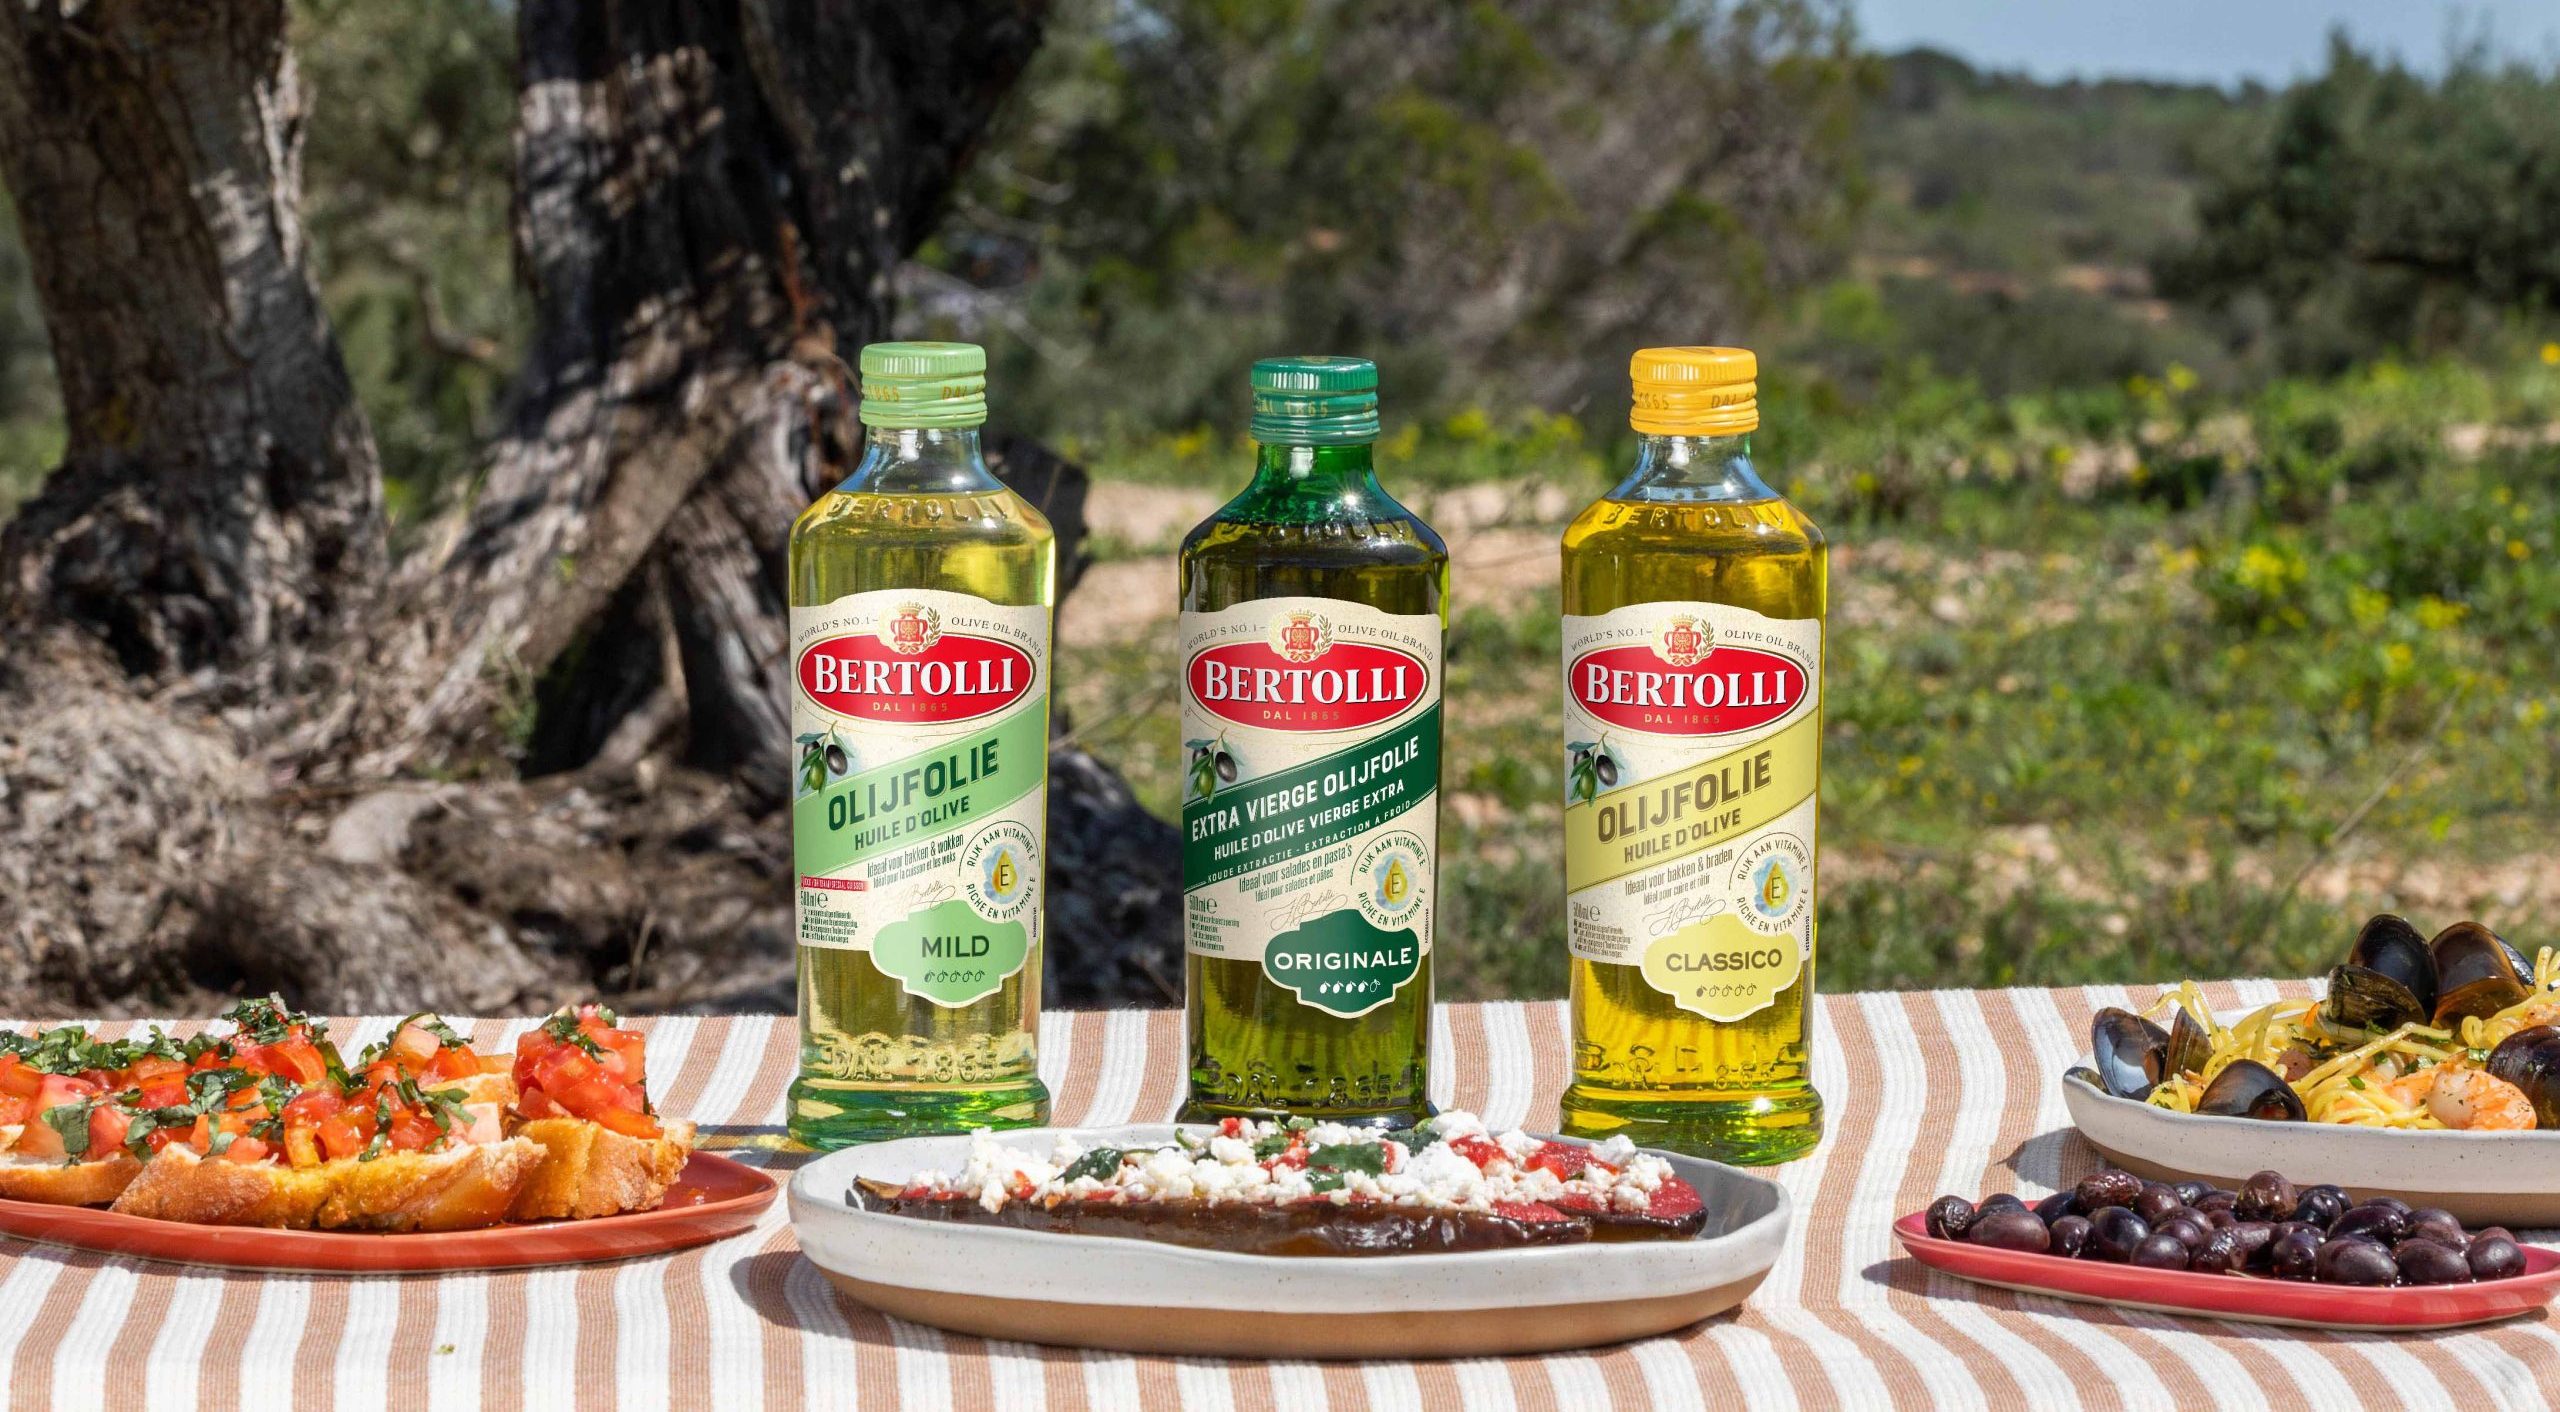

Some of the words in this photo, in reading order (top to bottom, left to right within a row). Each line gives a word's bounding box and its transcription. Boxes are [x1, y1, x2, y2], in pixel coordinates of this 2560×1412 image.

[798, 619, 840, 643] WORLD'S
[951, 616, 989, 630] OLIVE
[993, 621, 1012, 636] OIL
[1014, 629, 1043, 658] BRAND
[1186, 626, 1227, 651] WORLD'S
[1338, 624, 1376, 636] OLIVE
[1381, 629, 1399, 641] OIL
[1403, 635, 1434, 661] BRAND
[1571, 630, 1613, 652] WORLD'S
[1725, 628, 1762, 642] OLIVE
[1766, 634, 1784, 647] OIL
[1786, 641, 1815, 670] BRAND
[814, 653, 1014, 696] BERTOLLI
[1204, 659, 1407, 704] BERTOLLI
[1586, 662, 1788, 708] BERTOLLI
[873, 702, 901, 712] DAL
[911, 702, 948, 712] 1865
[1263, 710, 1292, 720] DAL
[1302, 711, 1340, 721] 1865
[1644, 713, 1673, 723] DAL
[1684, 714, 1720, 724] 1865
[828, 738, 1000, 831] OLIJFOLIE
[1192, 808, 1240, 842] EXTRA
[1245, 779, 1318, 822] VIERGE
[1323, 735, 1420, 797] OLIJFOLIE
[1598, 750, 1772, 844] OLIJFOLIE
[855, 820, 900, 851] HUILE
[906, 795, 970, 833] D'OLIVE
[1214, 836, 1249, 861] HUILE
[1252, 818, 1305, 848] D'OLIVE
[1309, 798, 1360, 829] VIERGE
[1363, 778, 1405, 809] EXTRA
[1624, 838, 1671, 863] HUILE
[1676, 808, 1741, 846] D'OLIVE
[904, 846, 928, 866] bakken
[930, 841, 936, 857] &
[937, 834, 964, 854] wokken
[967, 844, 983, 867] RIJK
[982, 828, 1001, 847] AAN
[1003, 827, 1033, 854] VITAMINE
[1028, 854, 1036, 862] E
[1207, 867, 1234, 883] KOUDE
[1237, 848, 1293, 875] EXTRACTIE
[1304, 821, 1371, 852] EXTRACTION
[1384, 801, 1410, 820] FROID
[1360, 852, 1376, 874] RIJK
[1375, 838, 1392, 855] AAN
[1394, 836, 1424, 860] VITAMINE
[1418, 859, 1426, 867] E
[1738, 858, 1754, 880] RIJK
[1754, 841, 1772, 858] AAN
[1775, 840, 1806, 866] VITAMINE
[1240, 873, 1260, 894] Ideaal
[1262, 869, 1278, 886] voor
[1280, 859, 1311, 880] salades
[1312, 854, 1322, 869] en
[1324, 842, 1352, 867] pasta's
[1625, 875, 1646, 896] Ideaal
[1649, 872, 1666, 888] voor
[1668, 863, 1696, 882] bakken
[1698, 856, 1704, 872] &
[1706, 849, 1733, 869] braden
[966, 883, 987, 913] RICHE
[987, 907, 999, 920] EN
[1002, 884, 1034, 920] VITAMINE
[1358, 892, 1378, 920] RICHE
[1377, 914, 1390, 926] EN
[1392, 894, 1424, 926] VITAMINE
[1736, 896, 1758, 926] RICHE
[1758, 920, 1770, 932] EN
[1773, 897, 1806, 932] VITAMINE
[921, 935, 990, 958] MILD
[1274, 947, 1412, 970] ORIGINALE
[1666, 949, 1782, 972] CLASSICO
